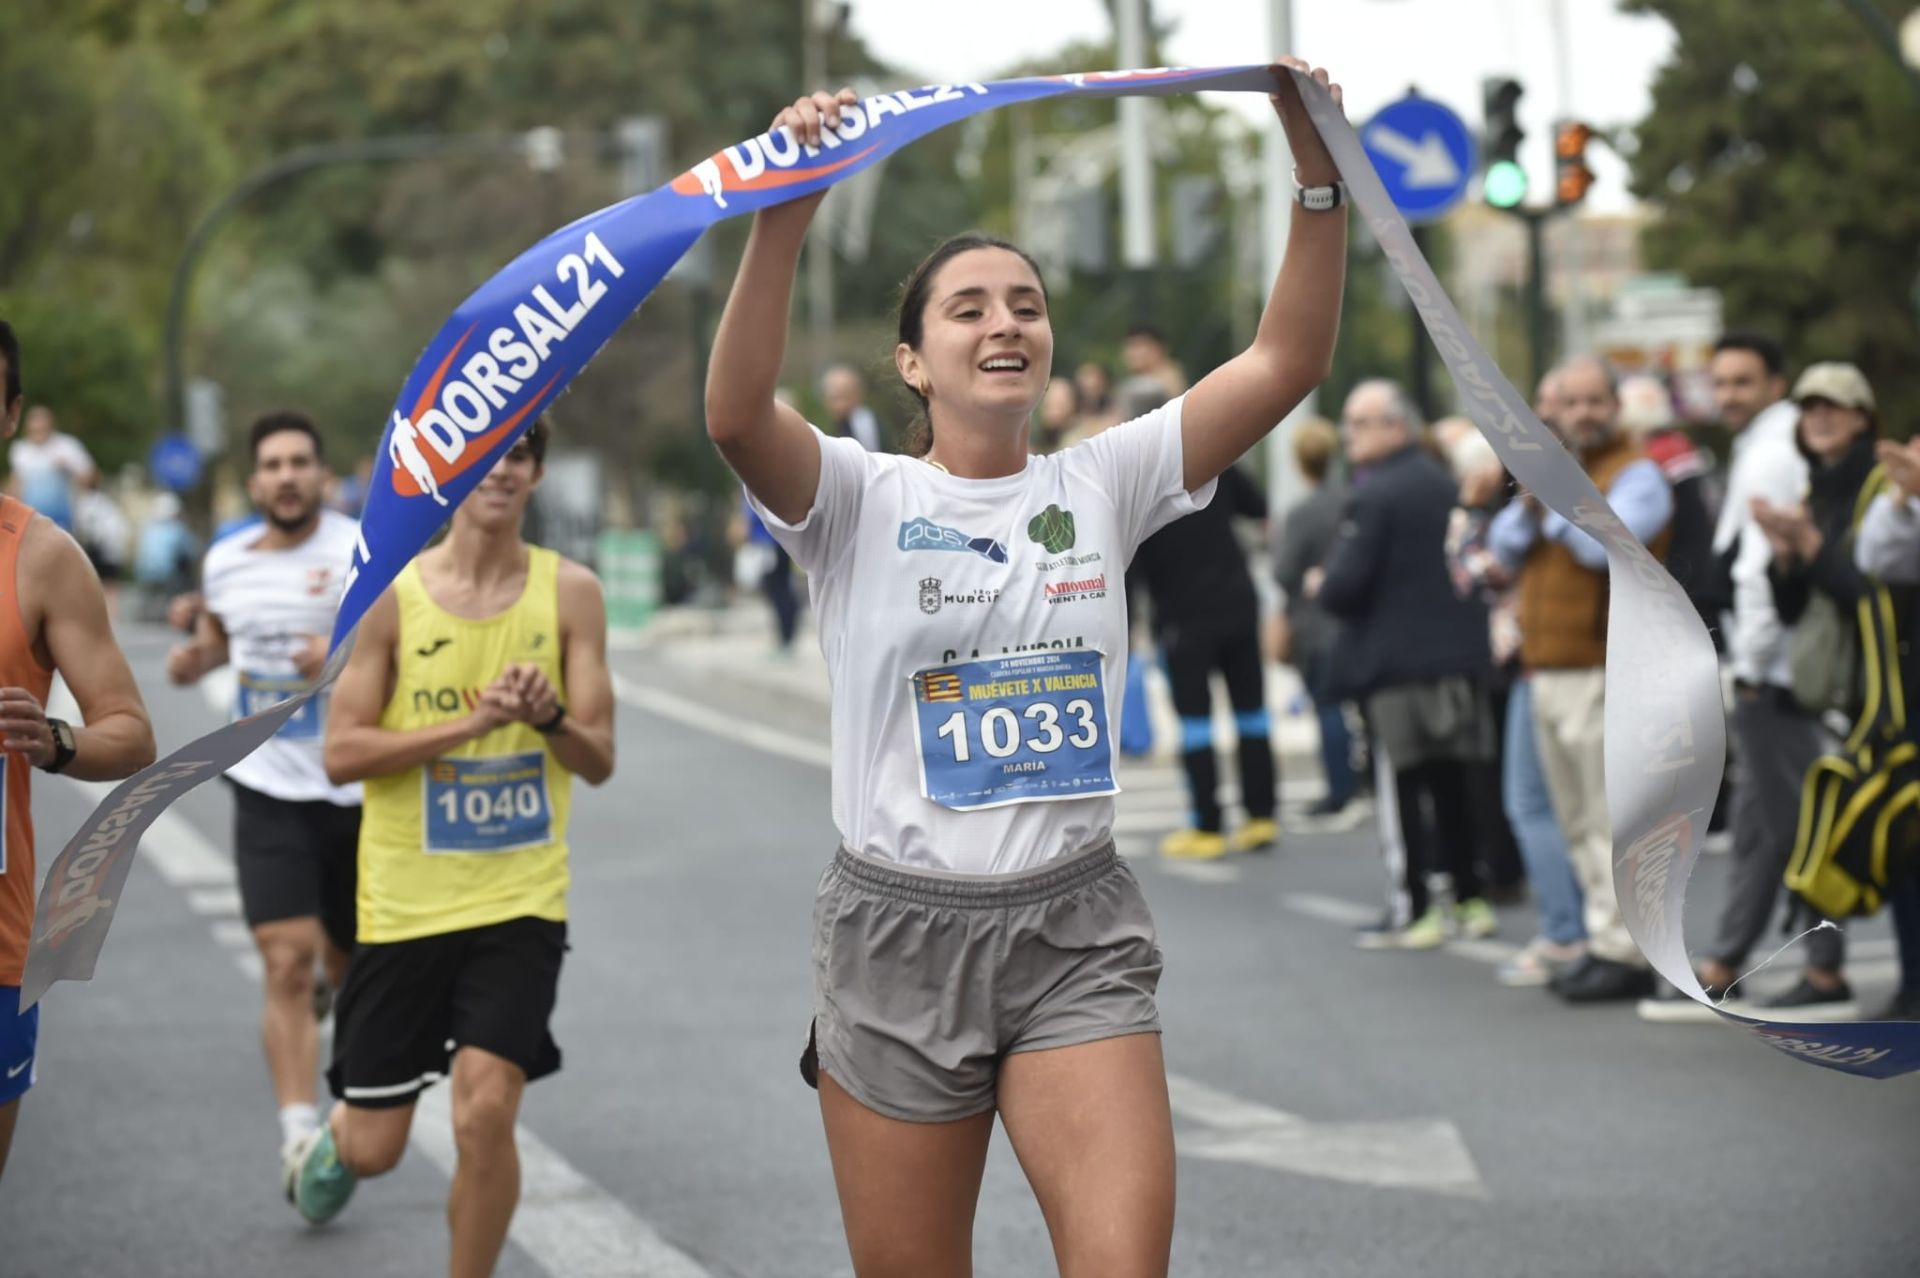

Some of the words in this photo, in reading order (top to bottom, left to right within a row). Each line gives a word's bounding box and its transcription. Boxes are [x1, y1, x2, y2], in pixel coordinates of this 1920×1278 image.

[415, 231, 625, 465] DORSAL21
[969, 680, 1030, 700] MUÉVETE
[1032, 679, 1042, 693] X
[1044, 674, 1097, 692] VALENCIA
[938, 699, 1098, 763] 1033
[437, 782, 541, 824] 1040
